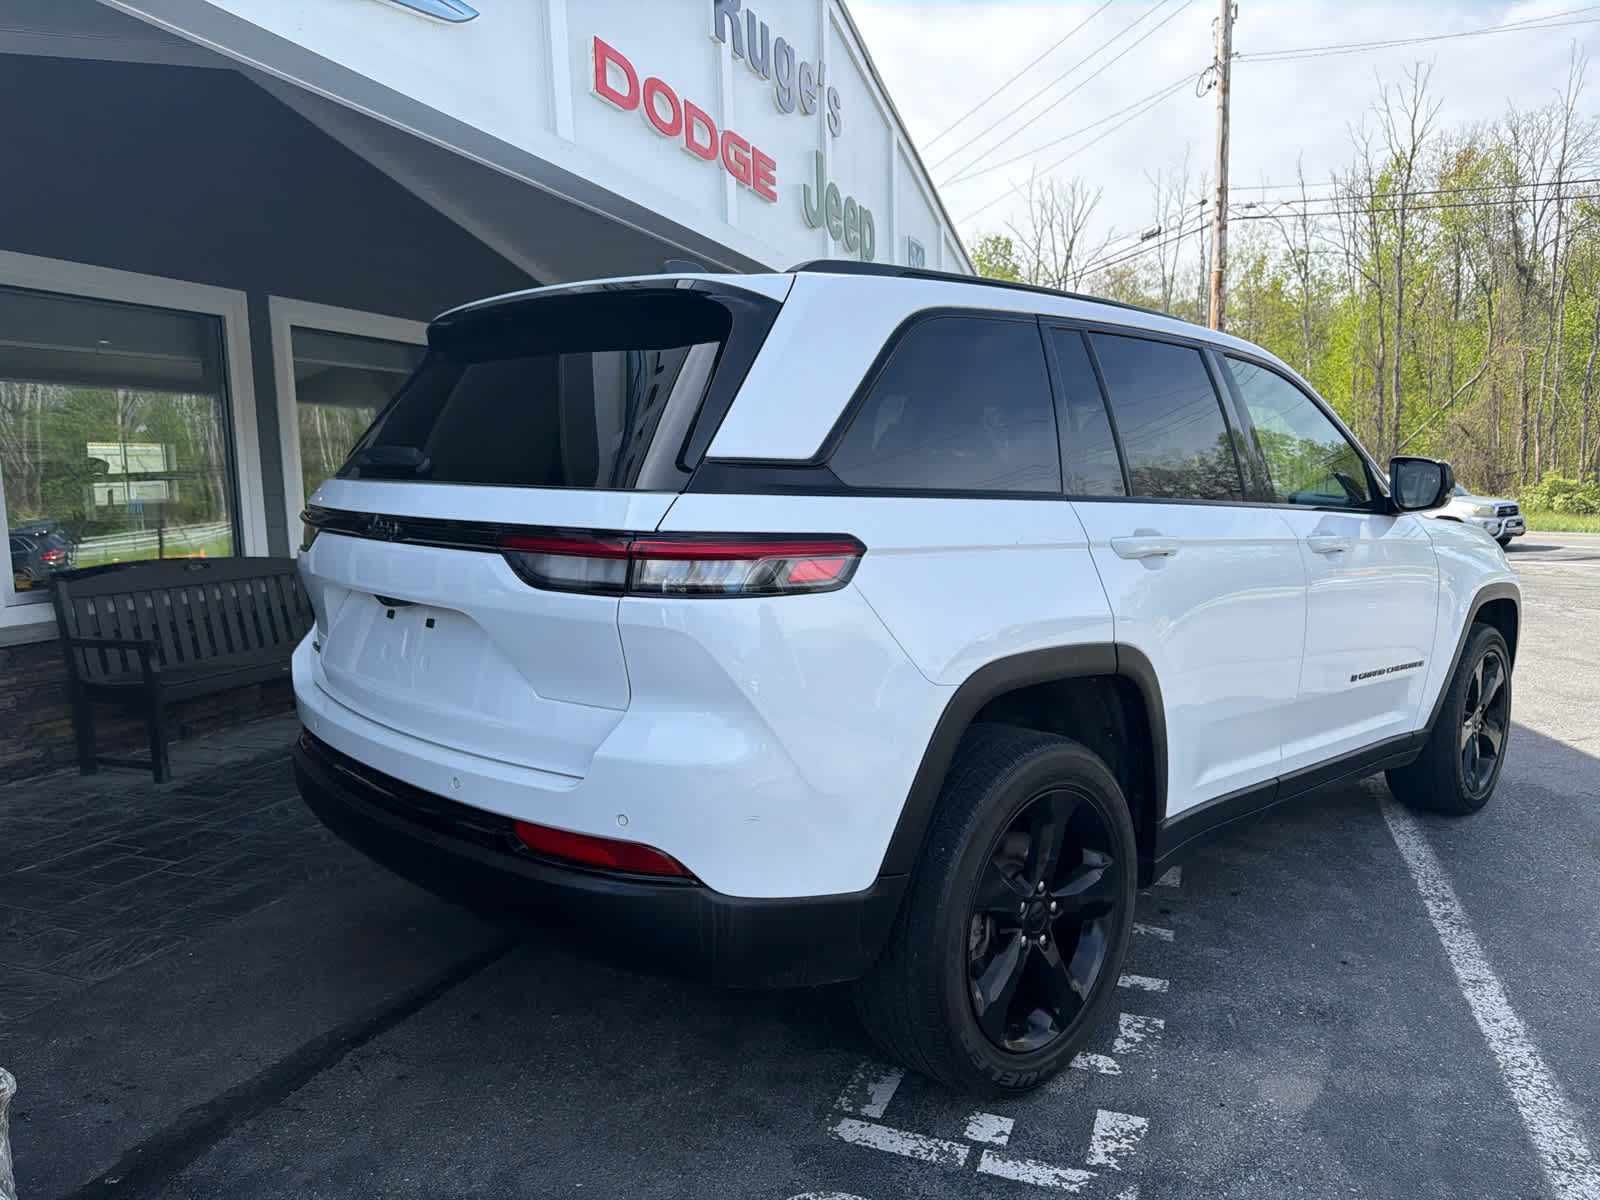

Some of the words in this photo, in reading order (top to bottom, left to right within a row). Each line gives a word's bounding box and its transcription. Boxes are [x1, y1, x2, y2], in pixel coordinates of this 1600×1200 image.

[592, 35, 777, 203] DODGE
[712, 0, 842, 137] Ruge's
[802, 150, 875, 262] Jeep
